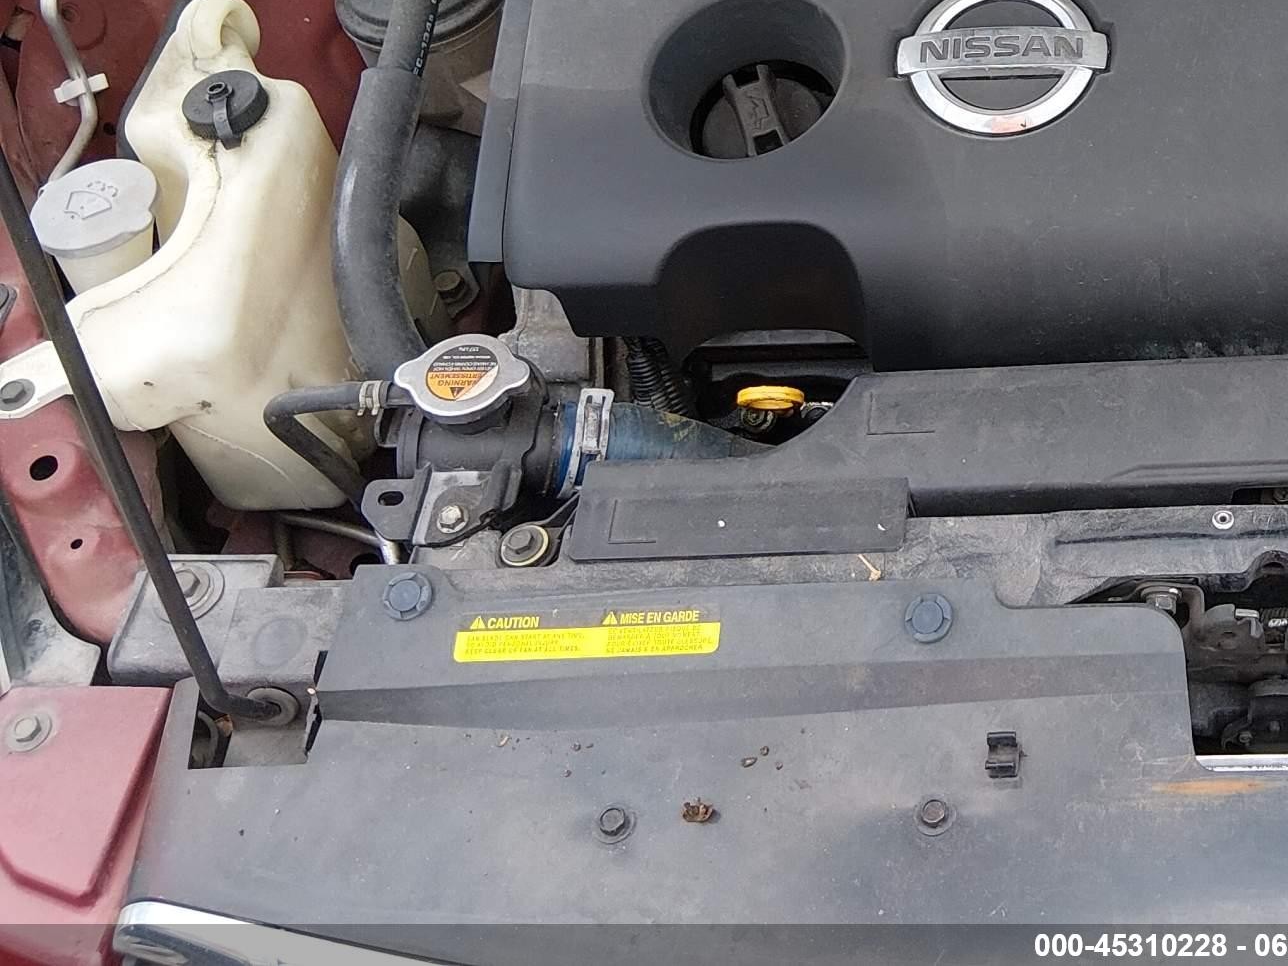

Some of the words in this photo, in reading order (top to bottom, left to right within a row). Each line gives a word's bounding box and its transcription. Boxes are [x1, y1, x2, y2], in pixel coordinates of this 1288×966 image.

[919, 35, 1084, 63] NISSAN
[487, 616, 540, 629] CAUTION
[620, 611, 645, 624] MISE
[646, 611, 661, 624] EN
[663, 610, 700, 622] GARDE
